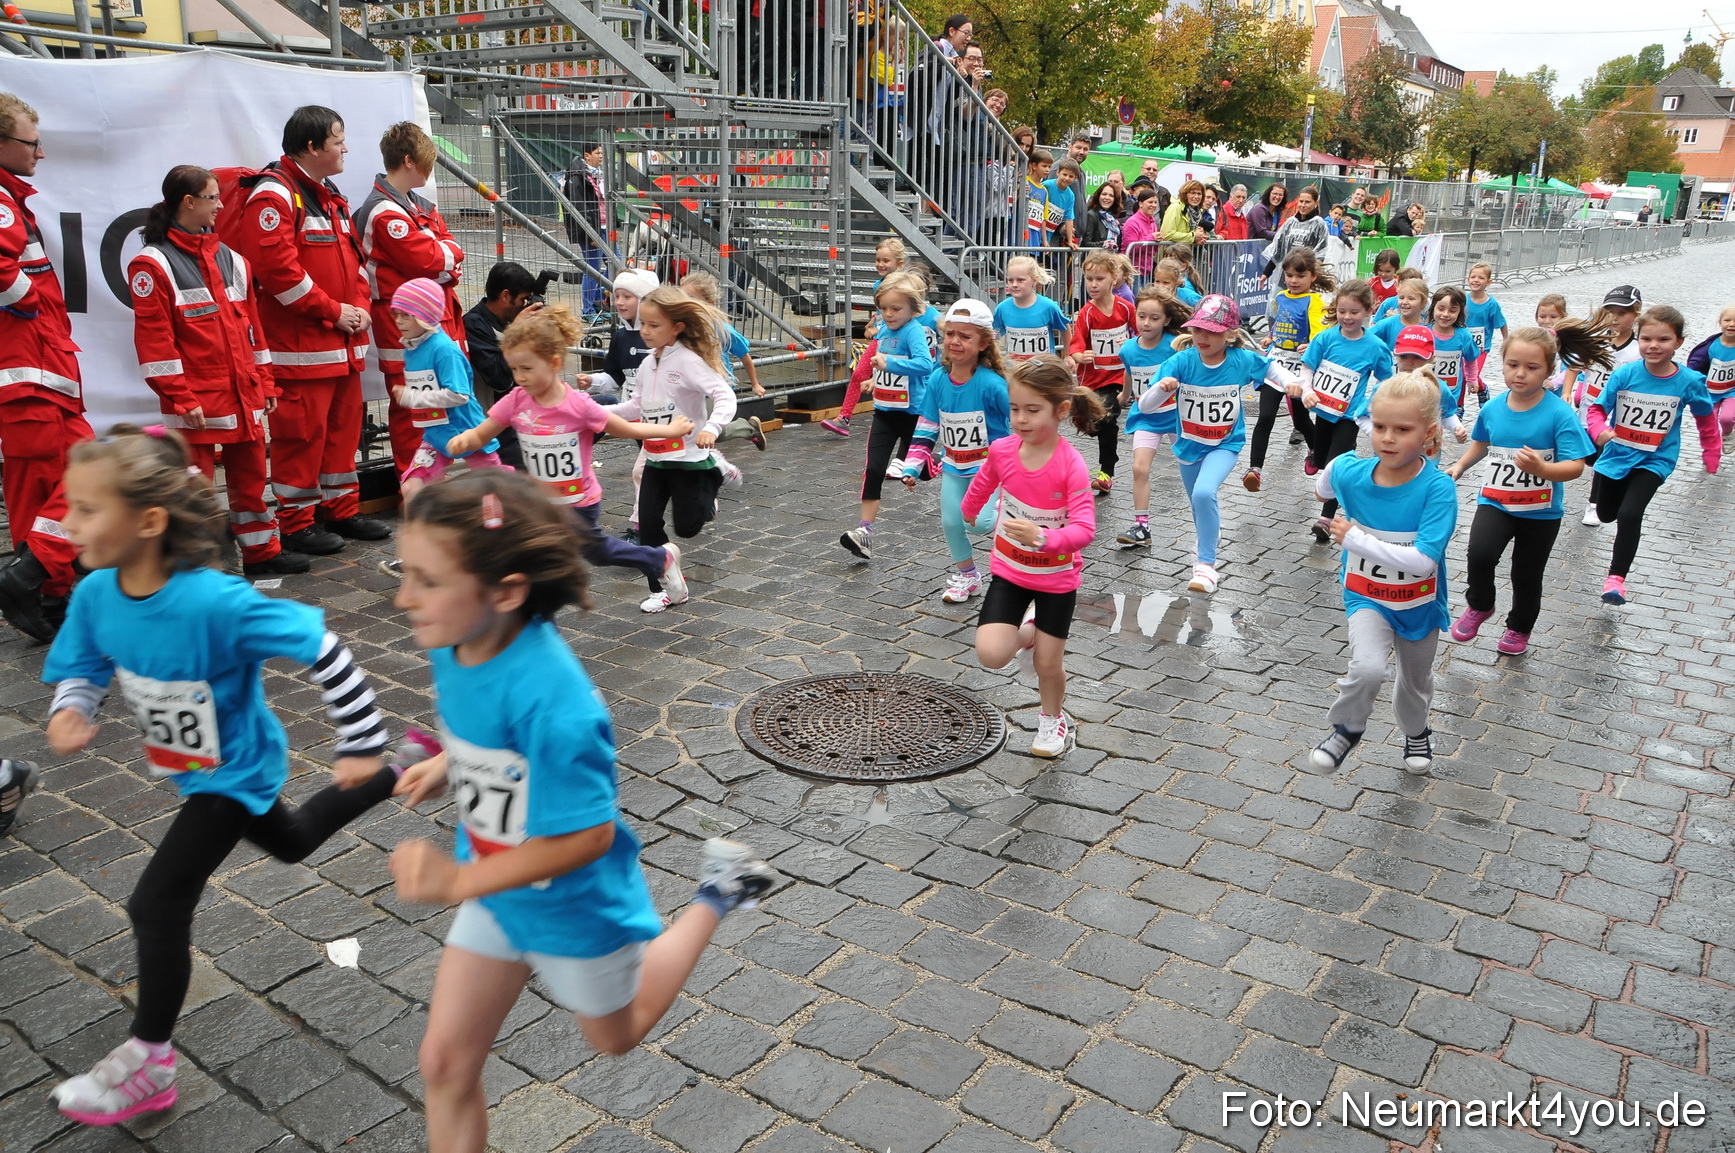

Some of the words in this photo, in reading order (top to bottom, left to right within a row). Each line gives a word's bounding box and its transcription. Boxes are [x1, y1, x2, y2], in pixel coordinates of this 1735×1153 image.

[1305, 117, 1311, 135] P
[1010, 337, 1047, 352] 7110
[1711, 367, 1735, 382] 708
[1315, 371, 1352, 399] 7074
[1199, 391, 1228, 399] Neumarkt
[1637, 398, 1669, 408] Neumarkt
[1184, 399, 1234, 423] 7152
[1620, 403, 1671, 430] 7242
[1195, 426, 1222, 437] Sophie
[1629, 431, 1651, 443] Katja
[534, 440, 567, 449] Neumarkt
[1021, 510, 1062, 522] Neumarkt
[1012, 549, 1050, 565] Sophie
[1367, 583, 1415, 600] Carlotta
